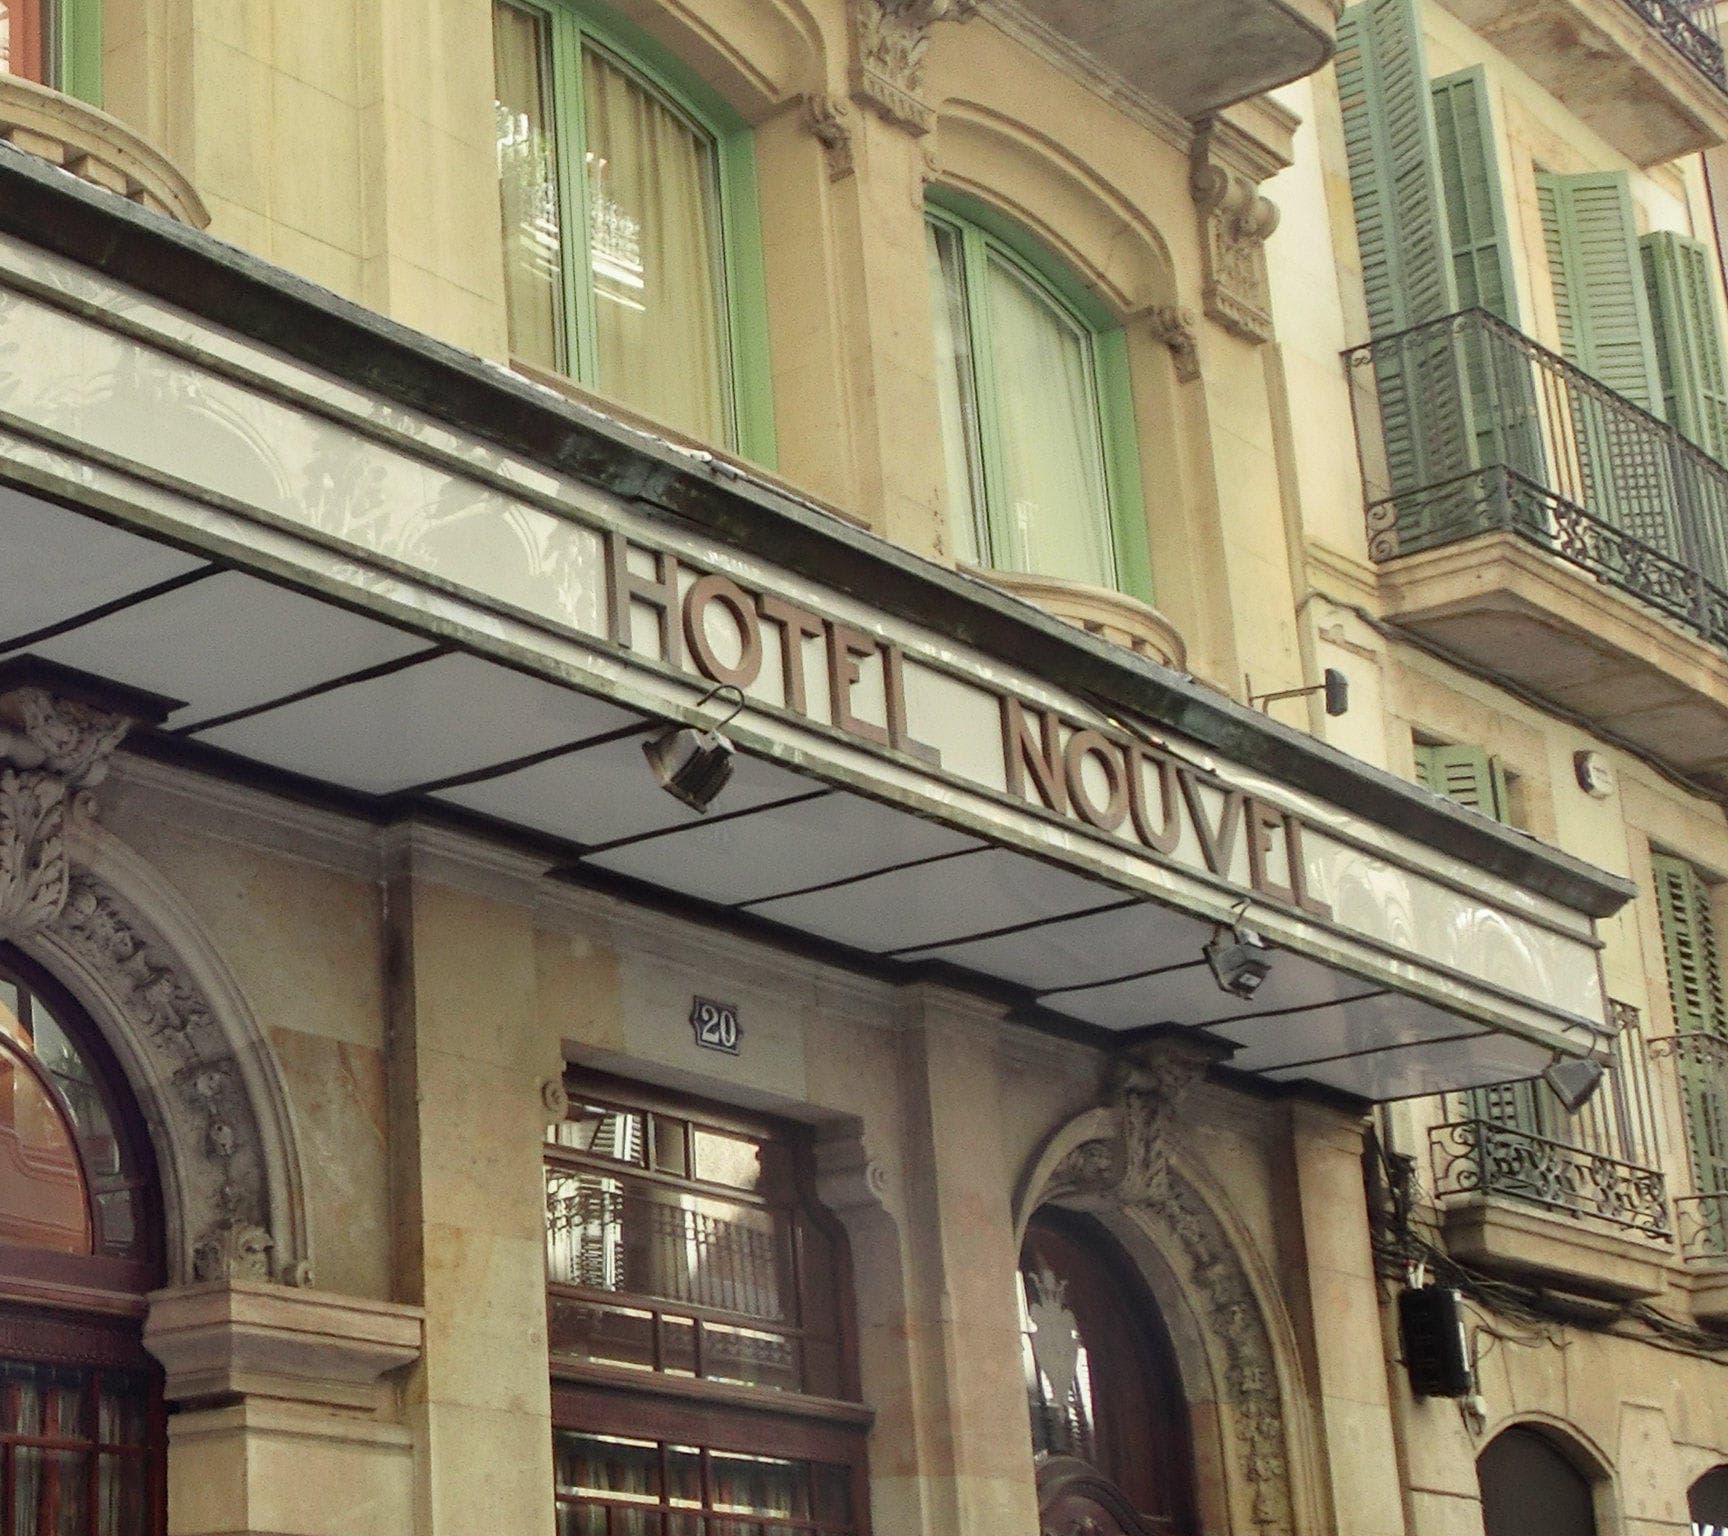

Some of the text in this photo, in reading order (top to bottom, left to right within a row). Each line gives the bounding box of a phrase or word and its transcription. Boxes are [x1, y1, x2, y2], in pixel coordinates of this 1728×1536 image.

[604, 529, 1334, 922] HOTEL NOUVEL
[701, 1005, 737, 1046] 20
